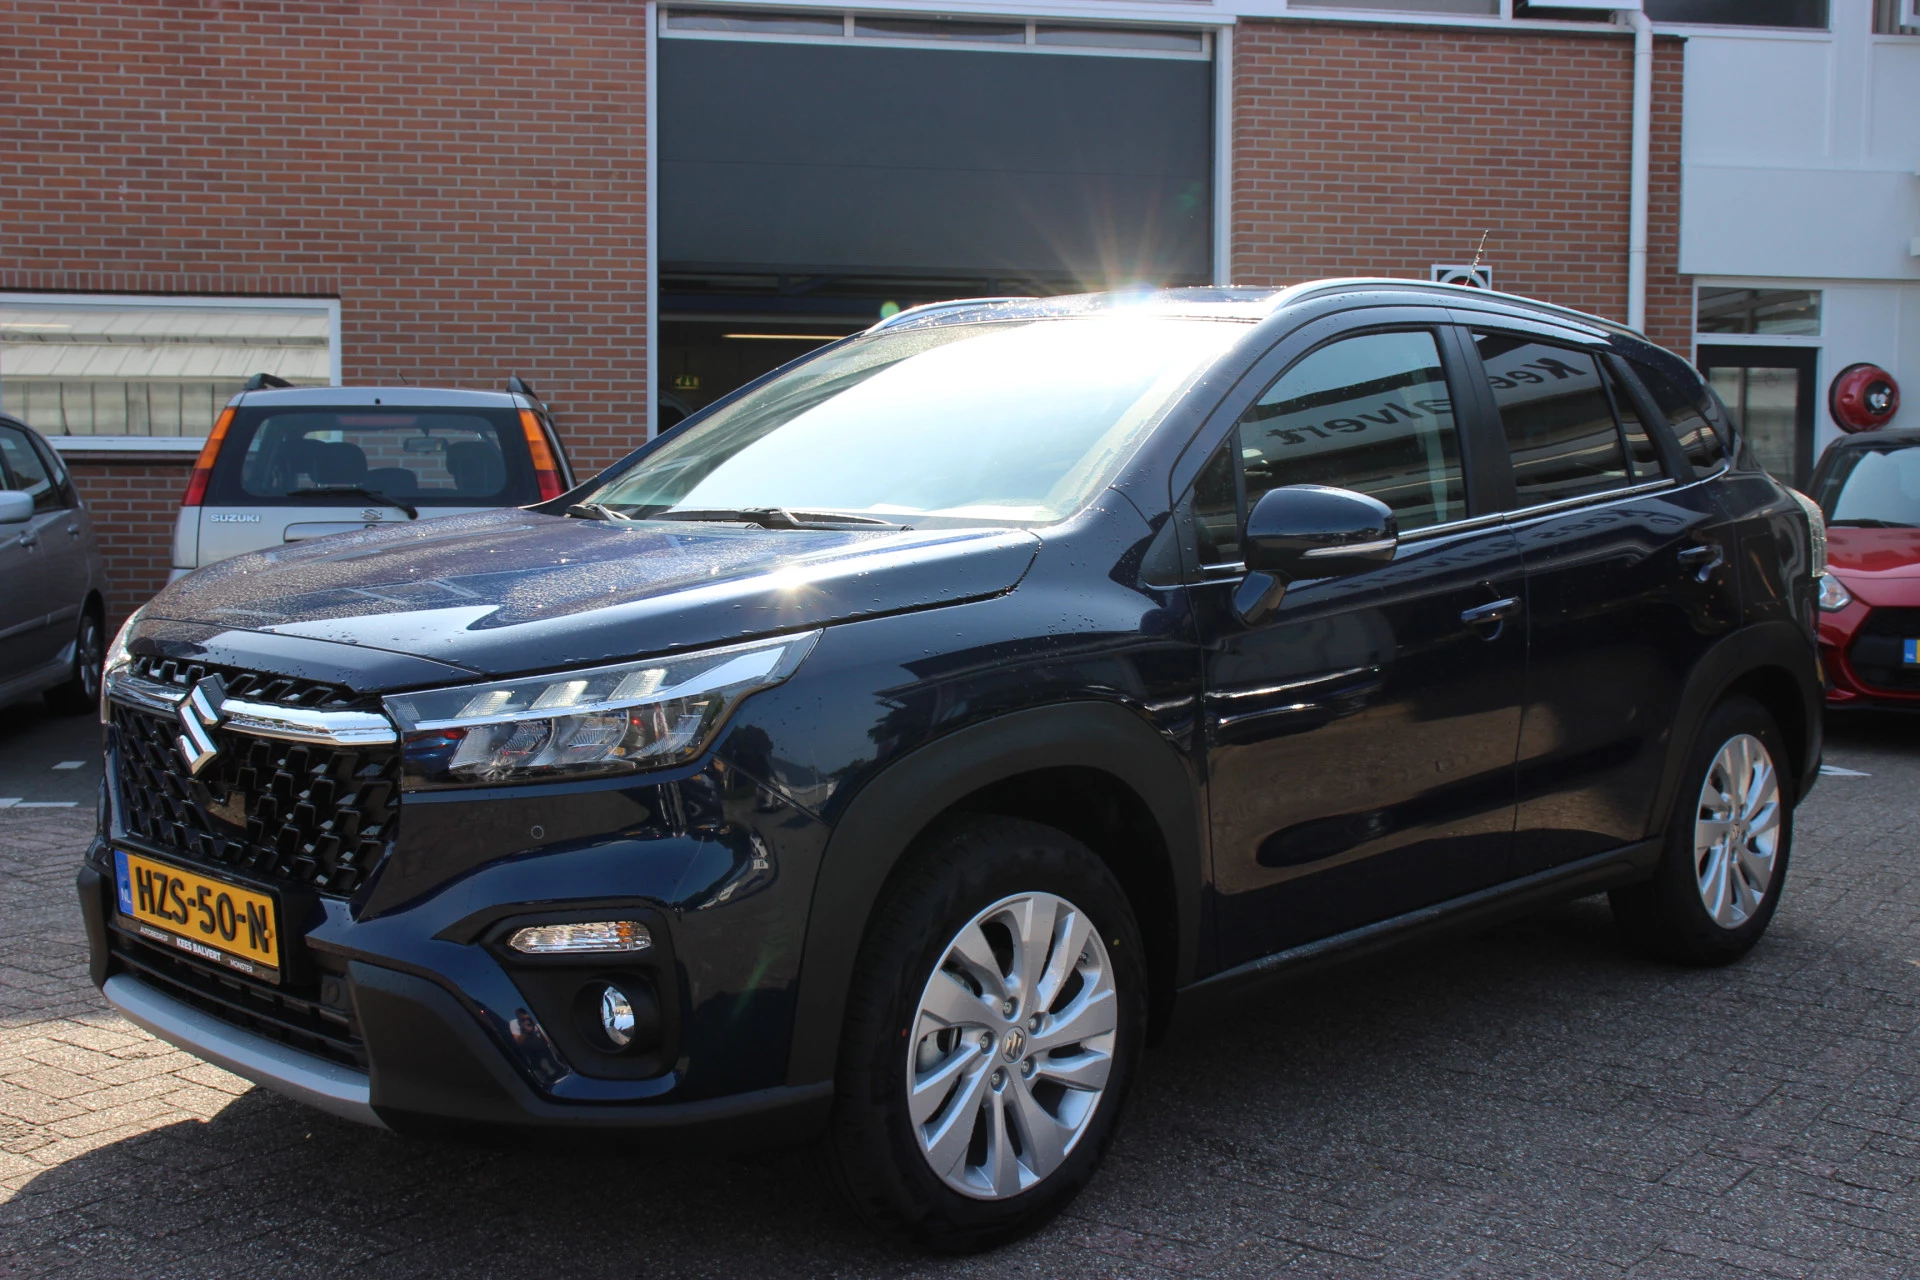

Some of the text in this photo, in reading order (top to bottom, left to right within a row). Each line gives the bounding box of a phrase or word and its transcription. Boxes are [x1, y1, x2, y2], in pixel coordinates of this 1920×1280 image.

[210, 513, 261, 522] SUZUKI
[120, 887, 131, 903] NL
[135, 866, 270, 954] HZS-50-N
[176, 937, 192, 951] KEES
[193, 942, 221, 961] BALVERT
[230, 959, 253, 973] MONSTER
